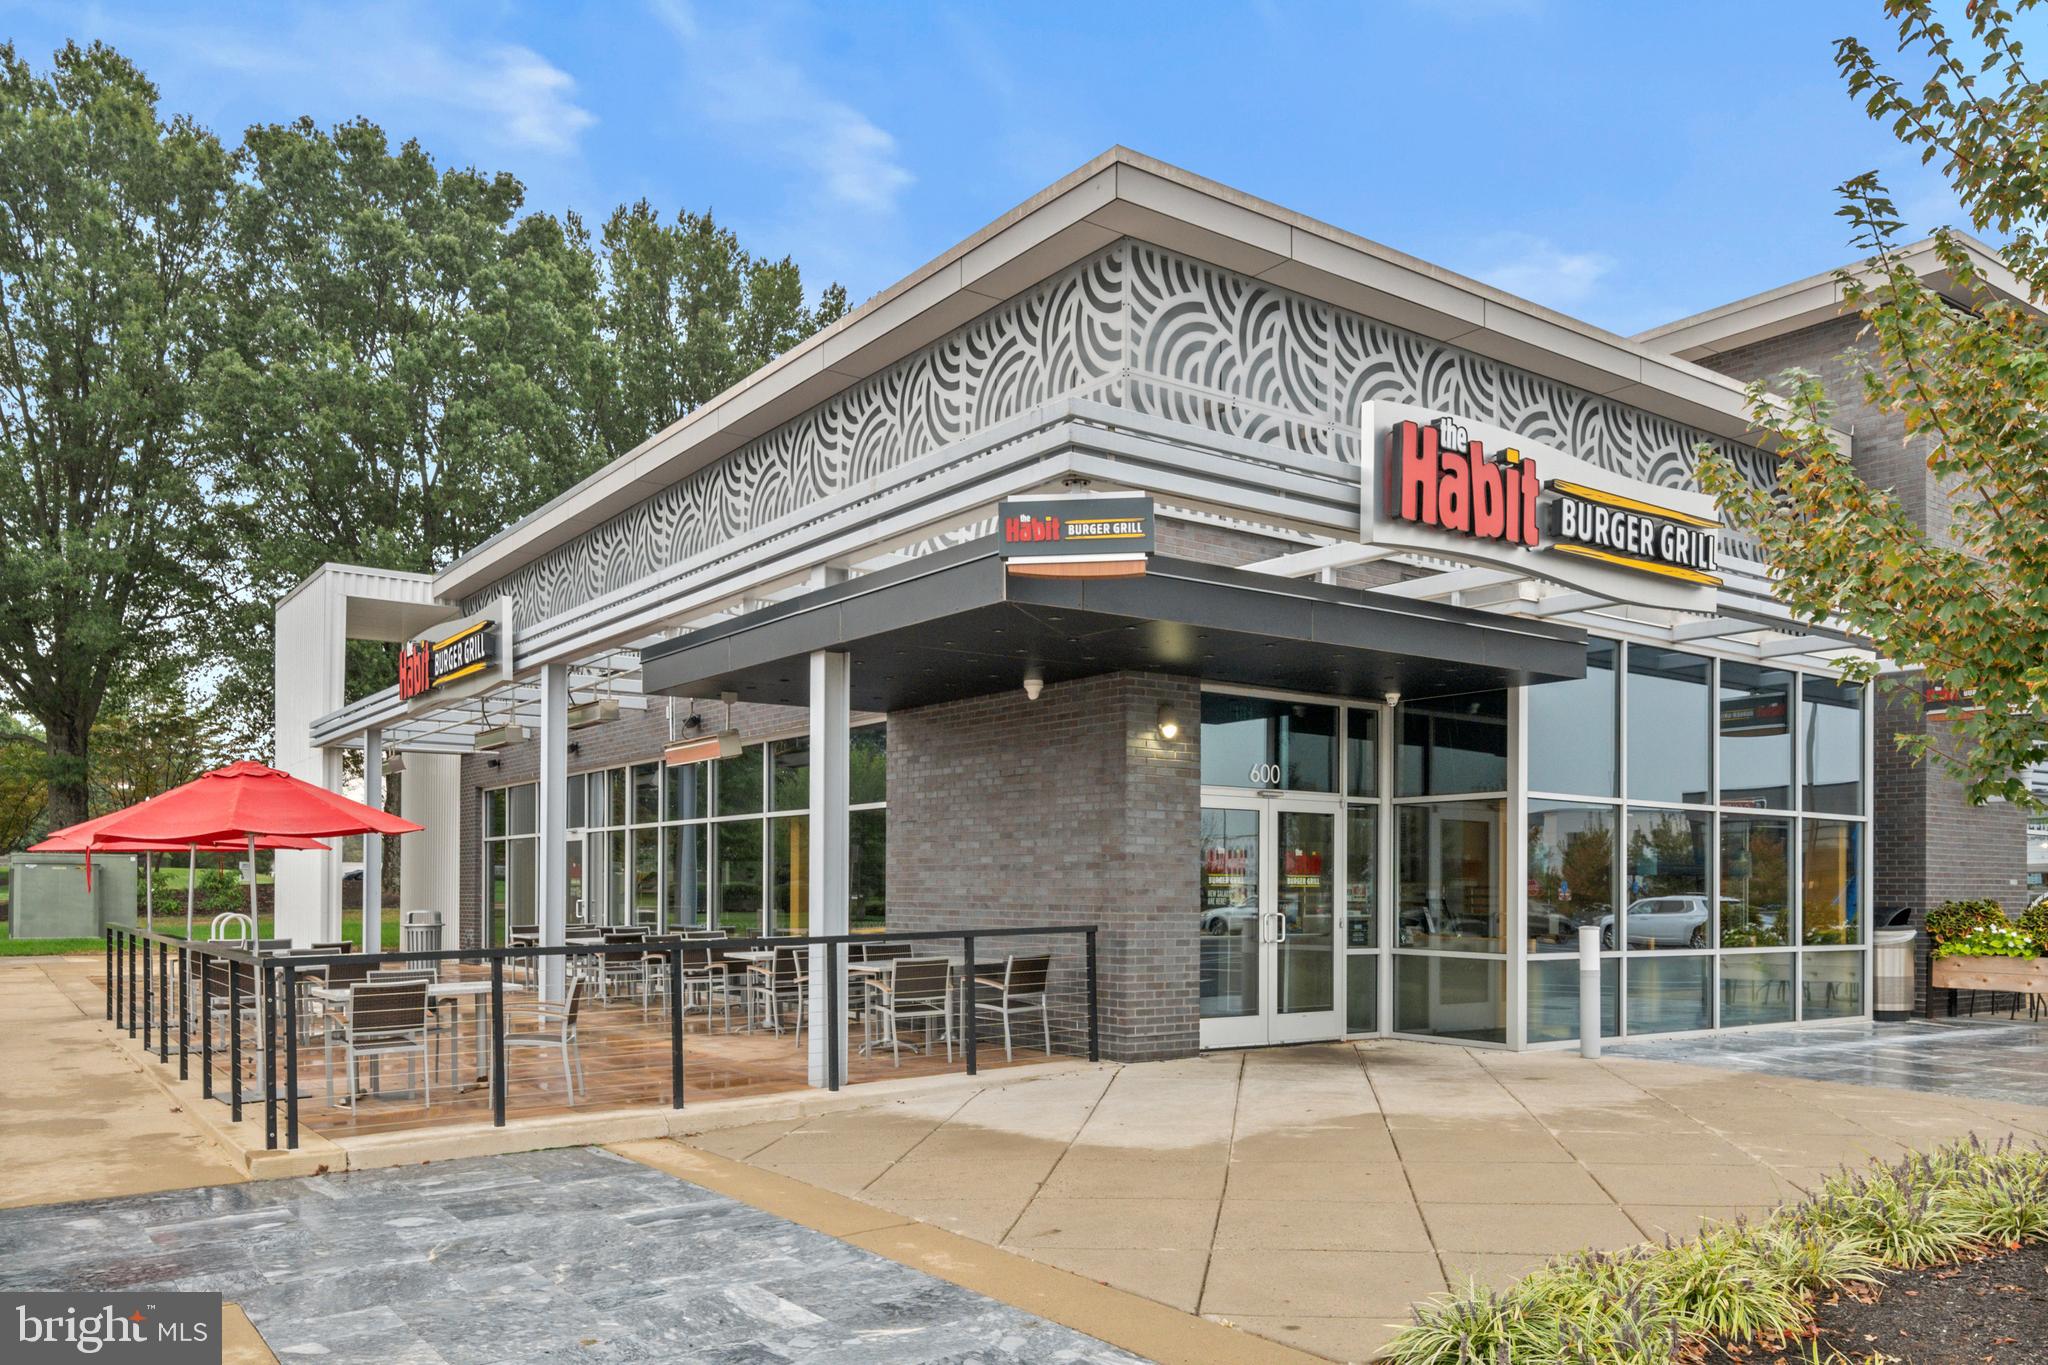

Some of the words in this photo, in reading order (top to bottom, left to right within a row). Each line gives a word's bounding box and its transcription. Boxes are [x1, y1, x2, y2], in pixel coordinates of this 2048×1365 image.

[1439, 416, 1468, 453] the
[1400, 419, 1540, 547] Habit
[1560, 497, 1656, 558] BURGER
[1660, 523, 1718, 572] GRILL
[1005, 516, 1060, 543] Habit
[1067, 522, 1110, 536] BURGER
[1113, 521, 1143, 534] GRILL
[1019, 513, 1031, 523] the
[398, 639, 430, 701] Habit
[434, 641, 463, 676] BURGER
[464, 632, 485, 664] GRILL
[1250, 763, 1280, 784] 600
